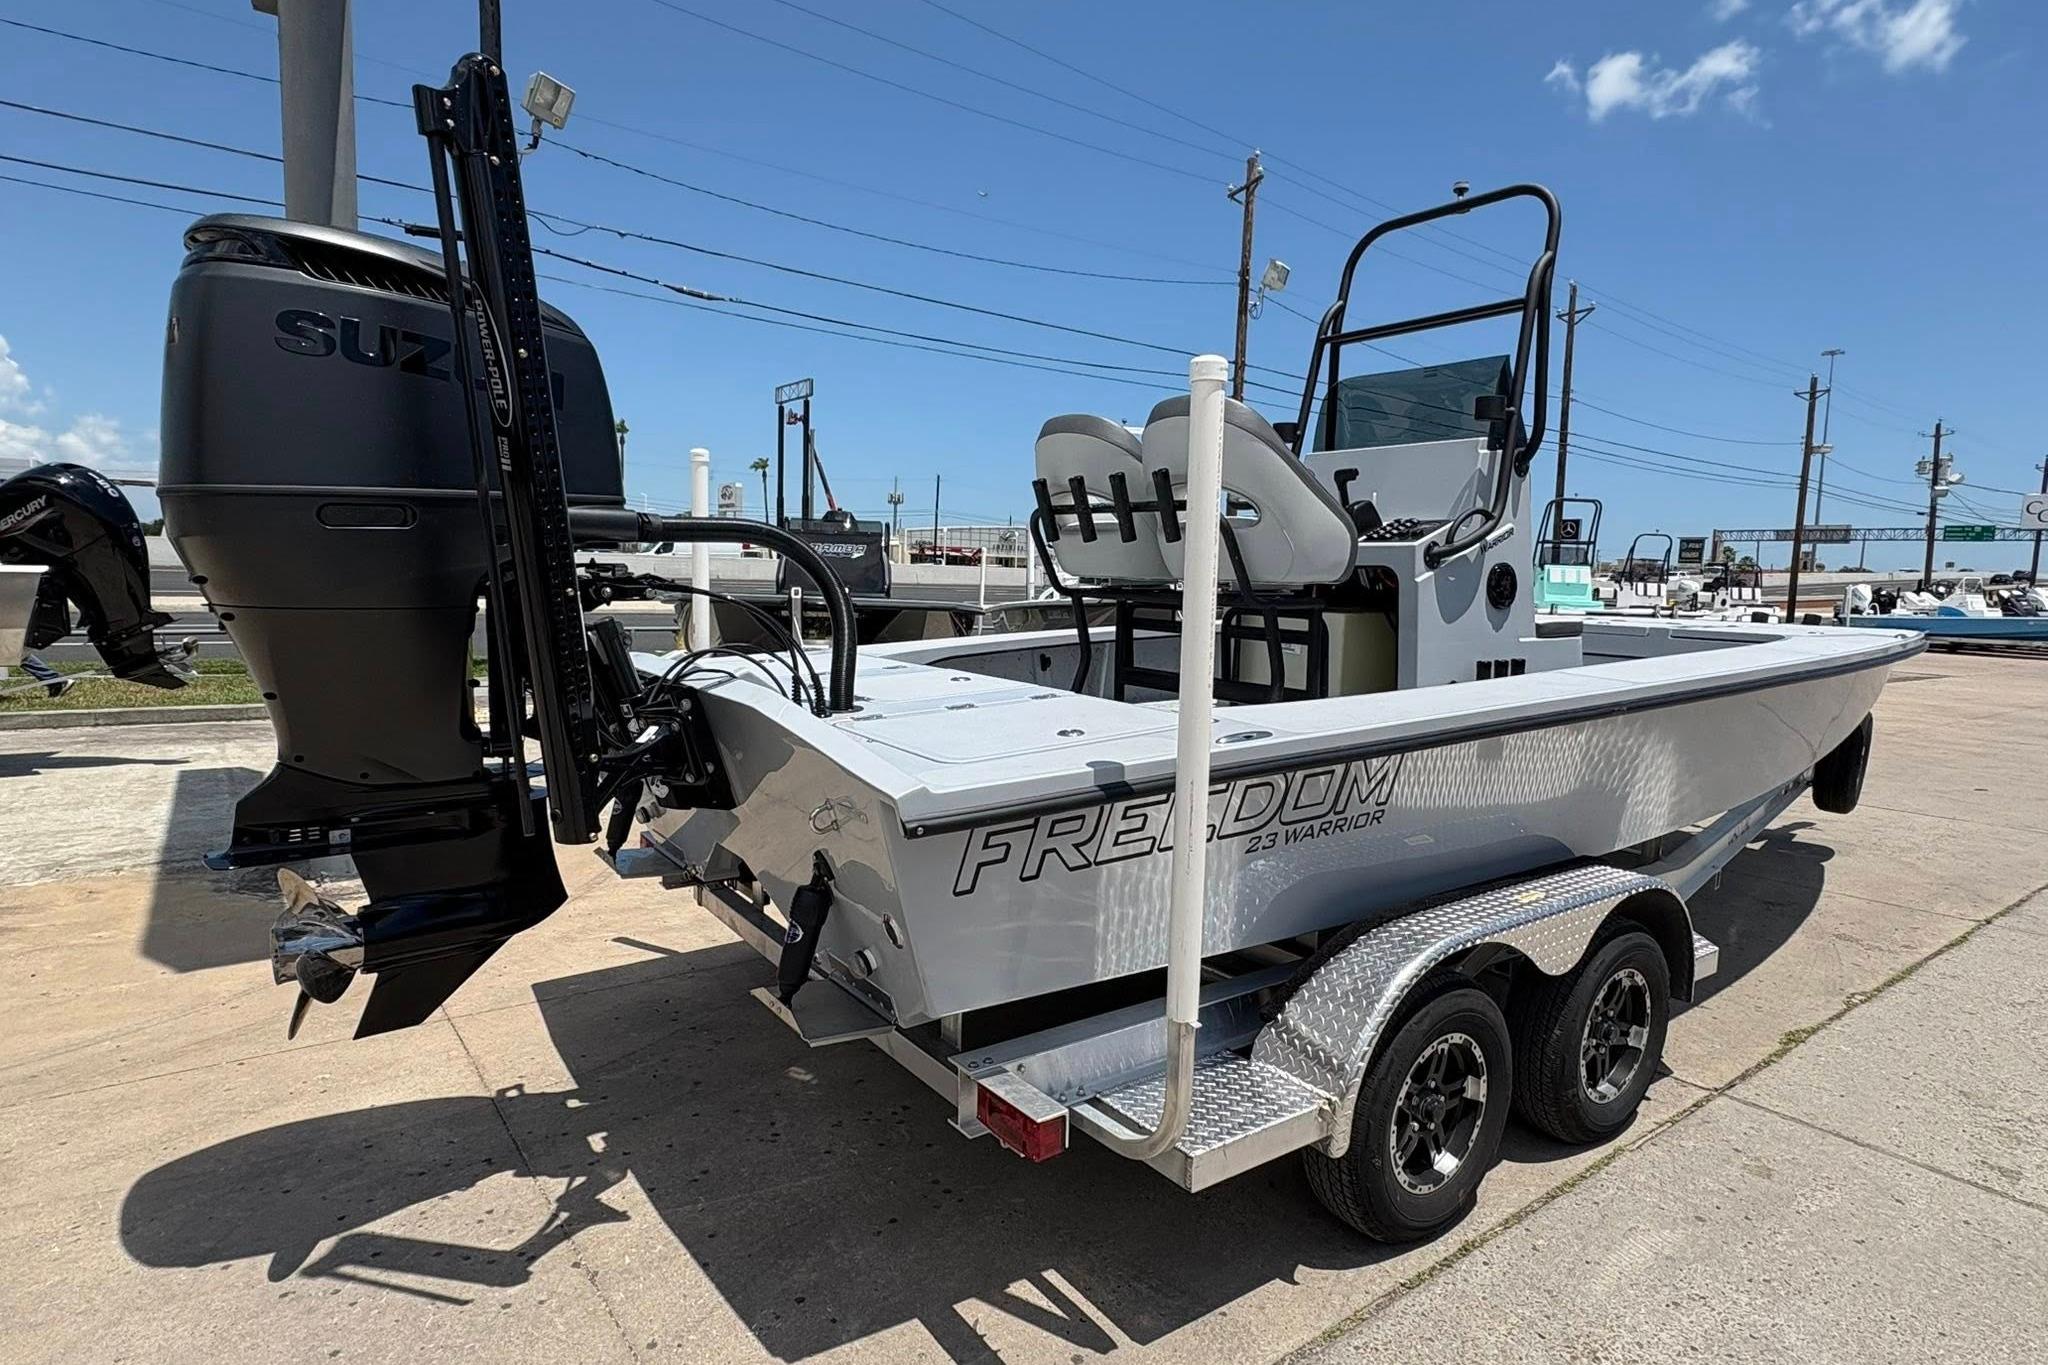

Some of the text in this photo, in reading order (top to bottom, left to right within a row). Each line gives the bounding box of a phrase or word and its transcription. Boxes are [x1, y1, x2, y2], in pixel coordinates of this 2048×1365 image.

[474, 299, 508, 411] POWER-POLE
[0, 495, 47, 530] ERCURY
[1245, 809, 1386, 854] 23 WARRIOR
